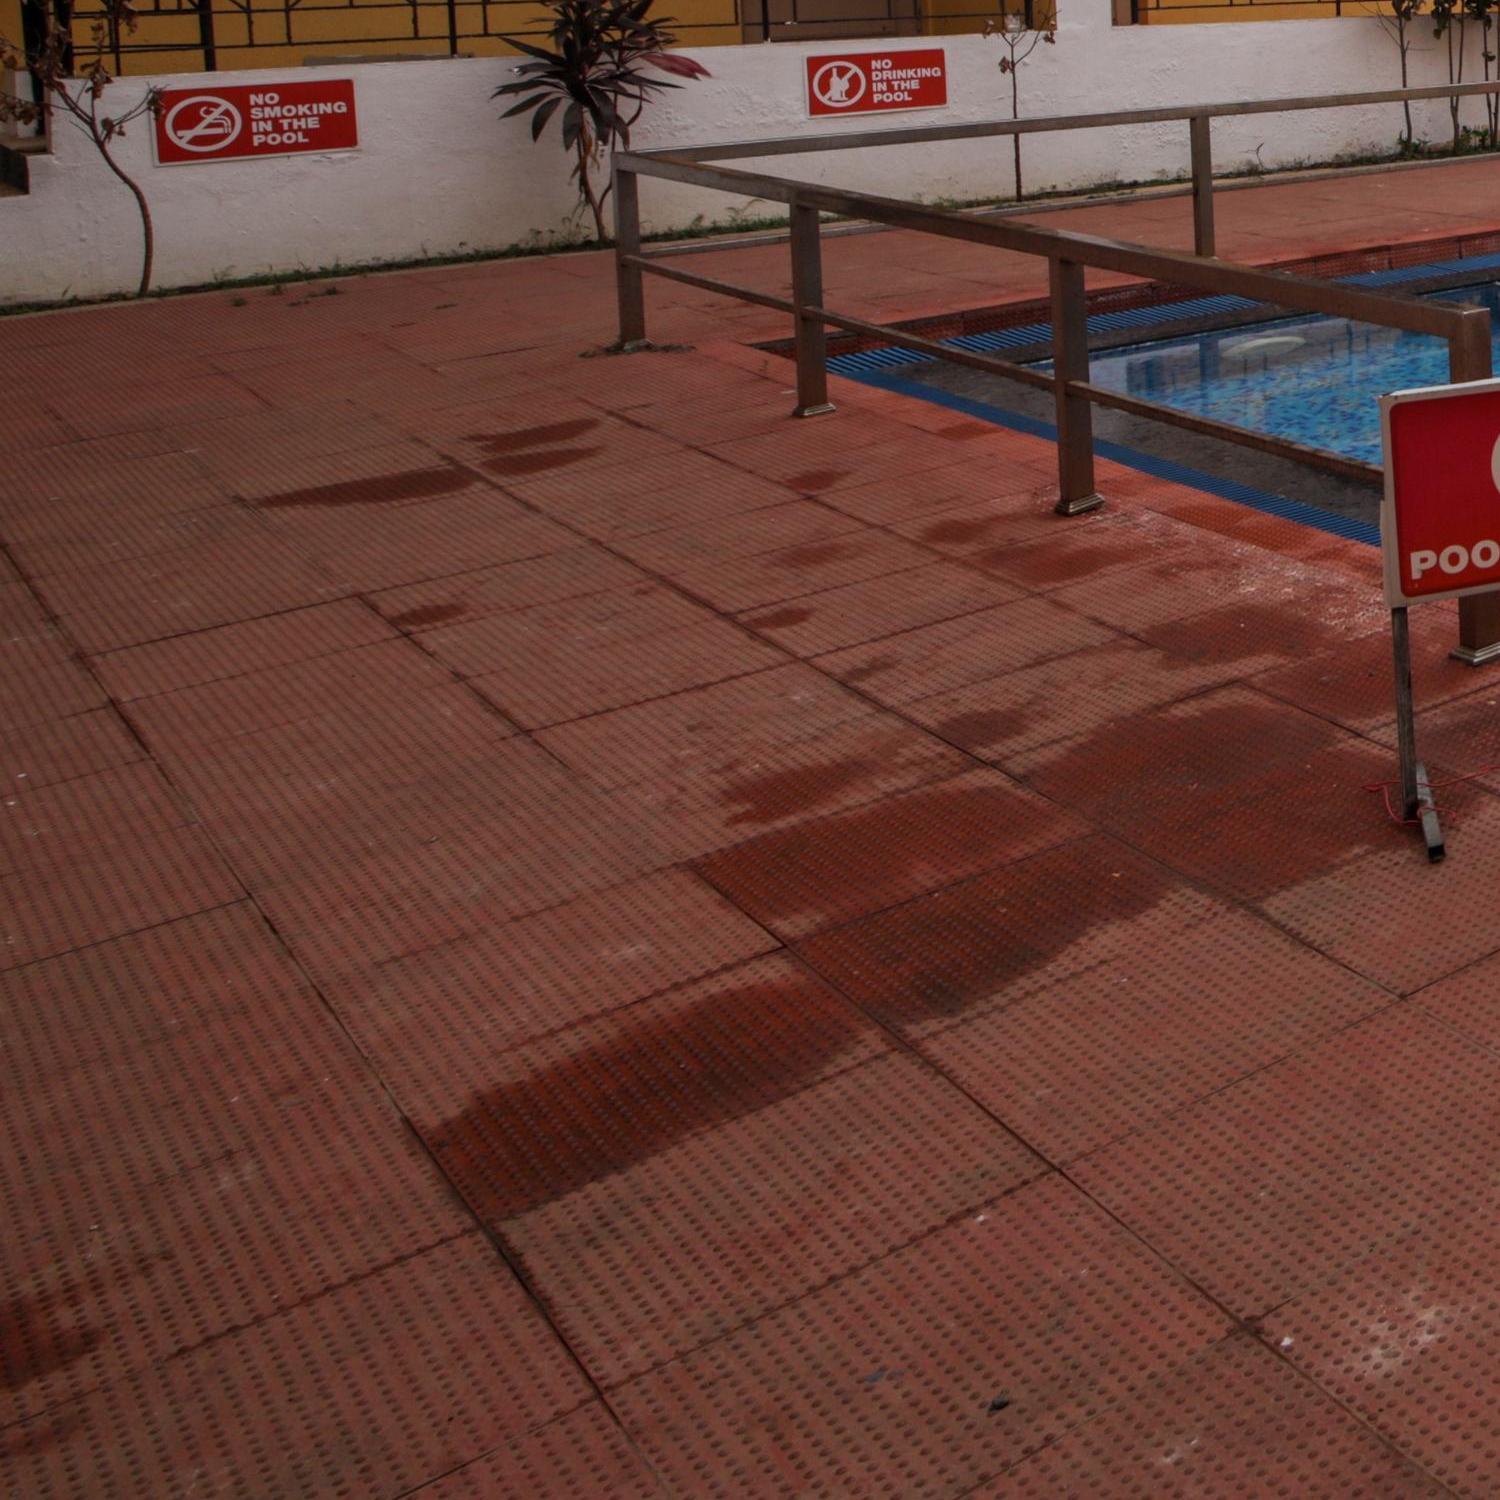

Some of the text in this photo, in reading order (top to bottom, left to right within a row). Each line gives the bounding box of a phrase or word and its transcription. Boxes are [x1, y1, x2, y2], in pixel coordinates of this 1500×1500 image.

[871, 59, 892, 70] NO
[871, 67, 942, 81] DRINKING
[872, 79, 920, 92] IN THE
[249, 92, 280, 106] NO
[873, 92, 913, 104] POOL
[250, 101, 348, 120] SMOKING
[251, 116, 320, 133] IN THE
[252, 131, 309, 148] POOL
